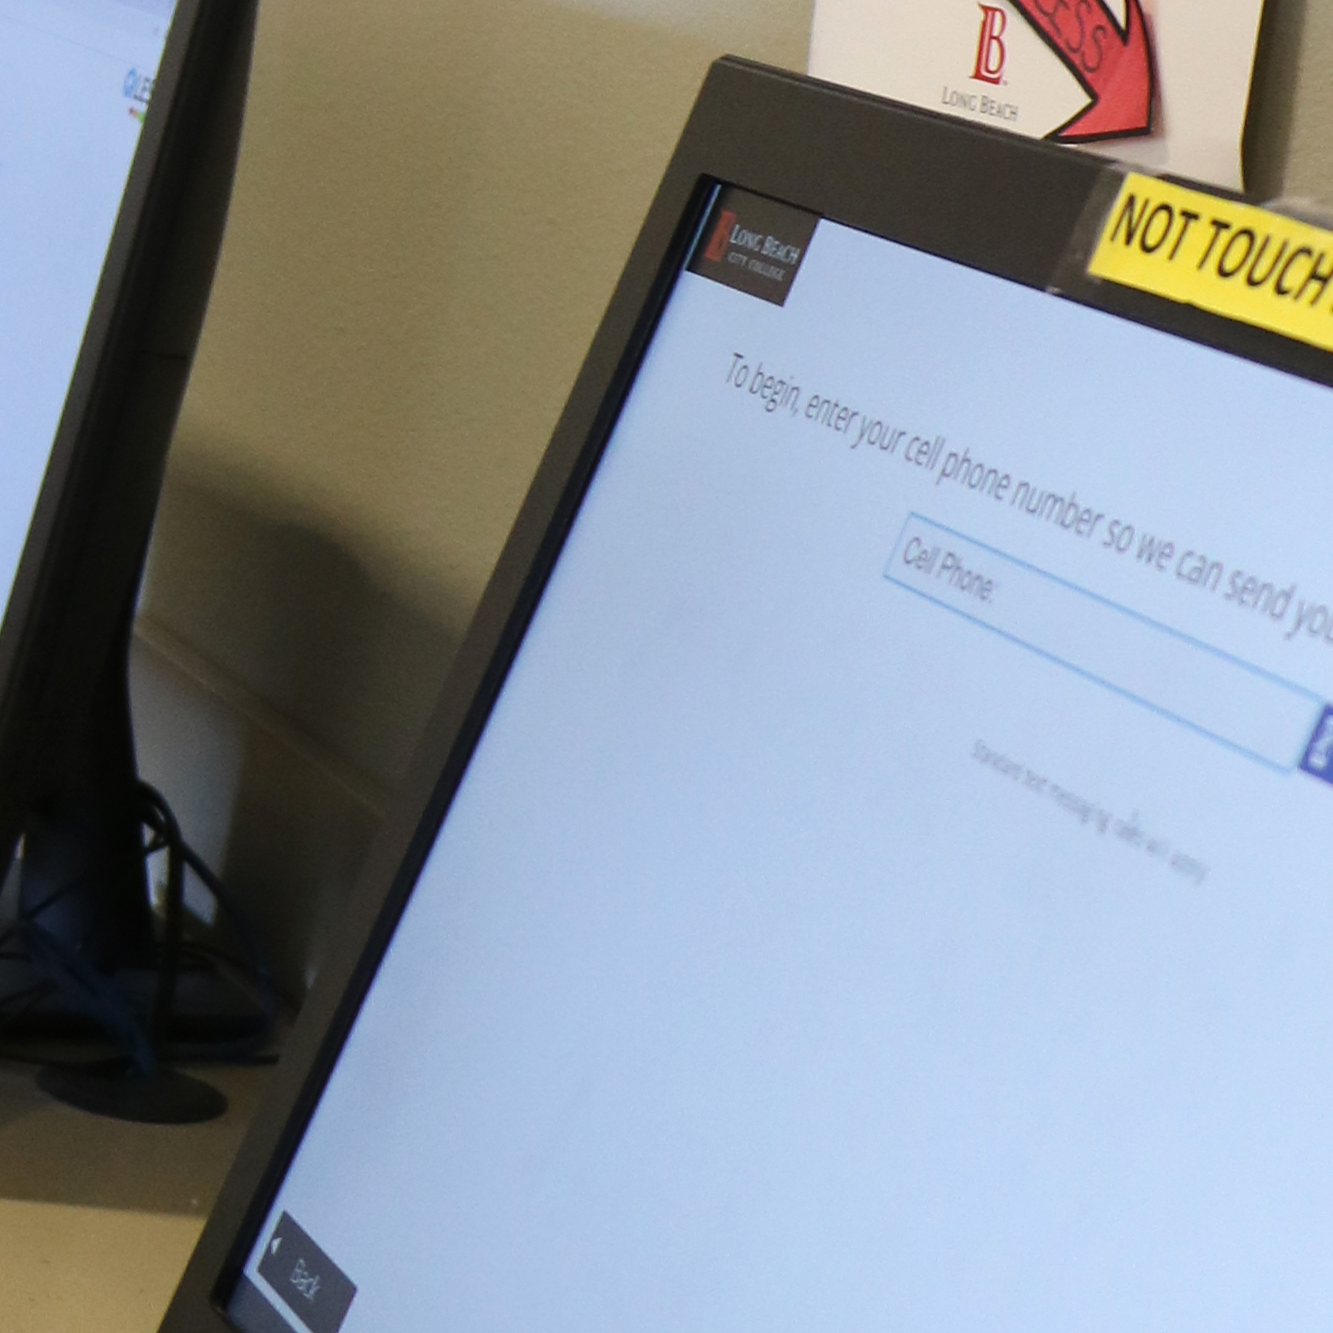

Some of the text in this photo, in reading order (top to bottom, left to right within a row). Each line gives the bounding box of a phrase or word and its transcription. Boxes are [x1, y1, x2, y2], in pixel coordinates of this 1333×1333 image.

[123, 68, 158, 105] QLE
[941, 86, 1019, 122] LONG BEACH
[729, 223, 764, 251] LONG
[760, 235, 801, 266] BEACH
[1110, 193, 1333, 307] NOT TOUCH
[725, 351, 750, 389] To
[747, 362, 803, 416] begin,
[804, 393, 859, 435] enter
[849, 414, 907, 455] your
[904, 434, 946, 471] cell
[935, 447, 1011, 502] phone
[1010, 480, 1105, 538] number
[1102, 518, 1135, 554] so
[1136, 533, 1176, 572] we
[1175, 549, 1224, 593] can
[1223, 568, 1297, 619] send
[903, 536, 940, 575] Cell
